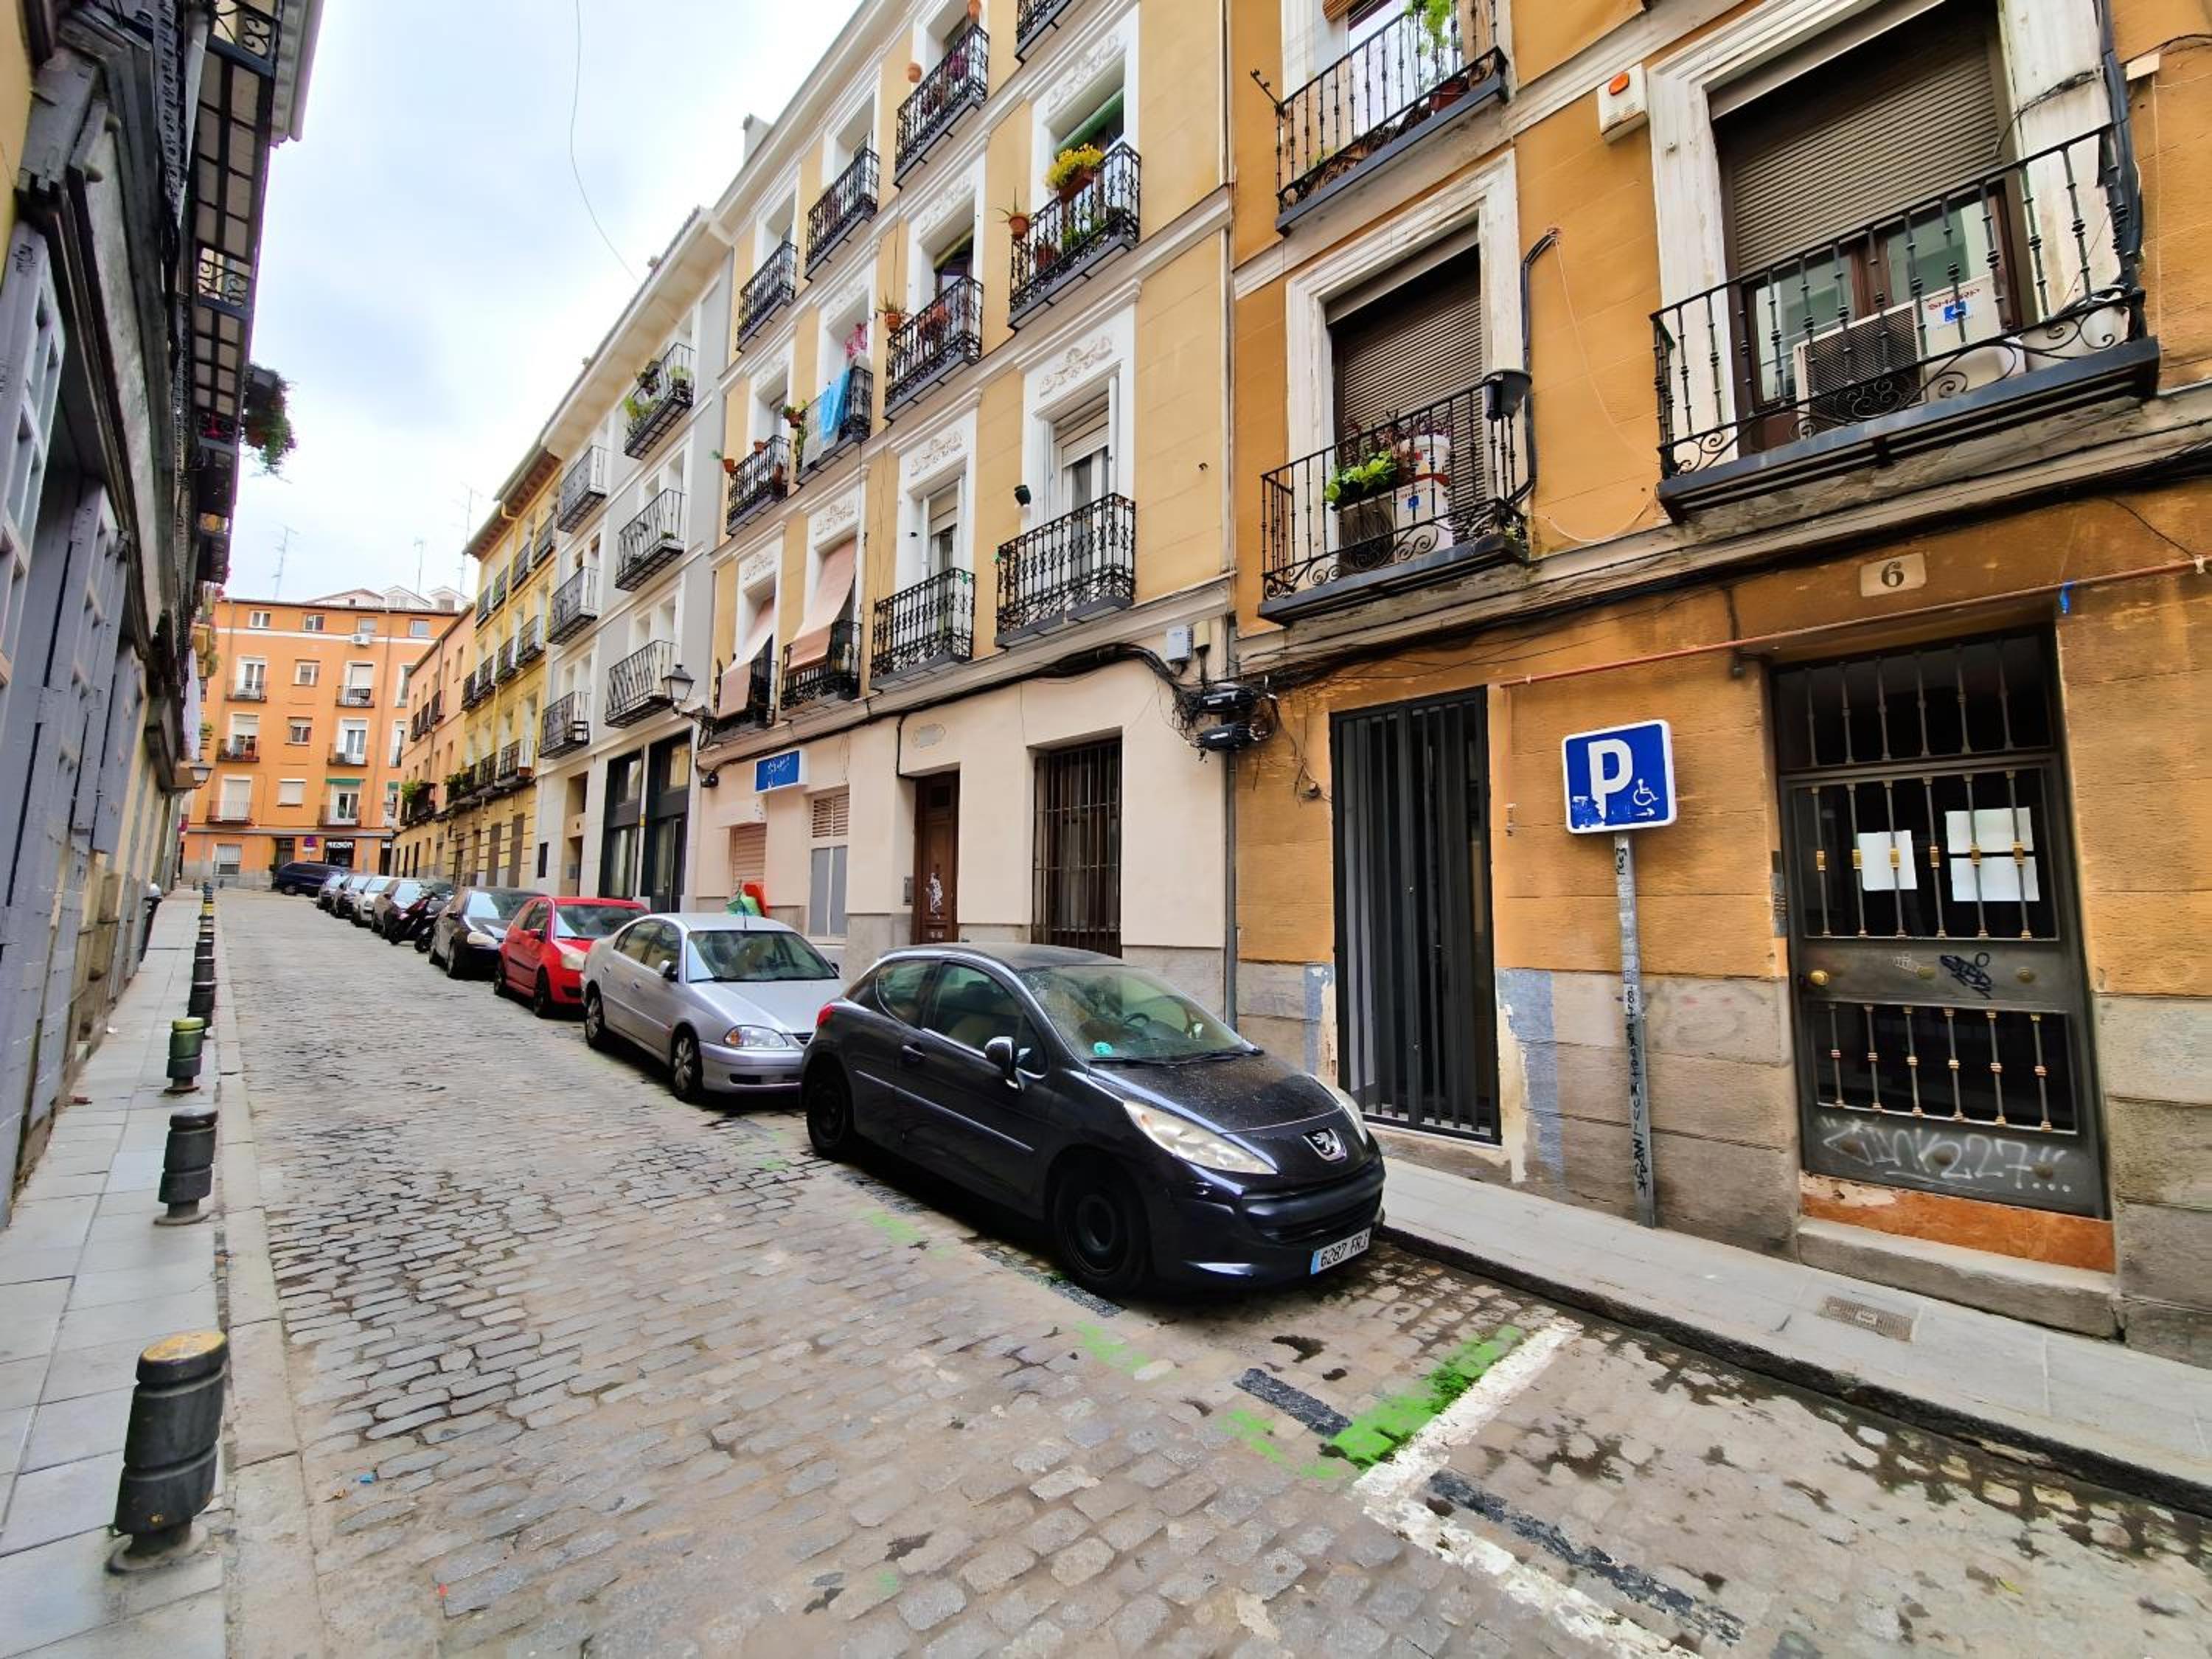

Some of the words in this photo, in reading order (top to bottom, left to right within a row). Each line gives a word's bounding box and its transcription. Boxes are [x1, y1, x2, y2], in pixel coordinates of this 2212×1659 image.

[1881, 561, 1905, 588] 6
[1587, 739, 1633, 820] P
[1321, 1242, 1347, 1267] 6287
[1351, 1232, 1368, 1254] FRJ
